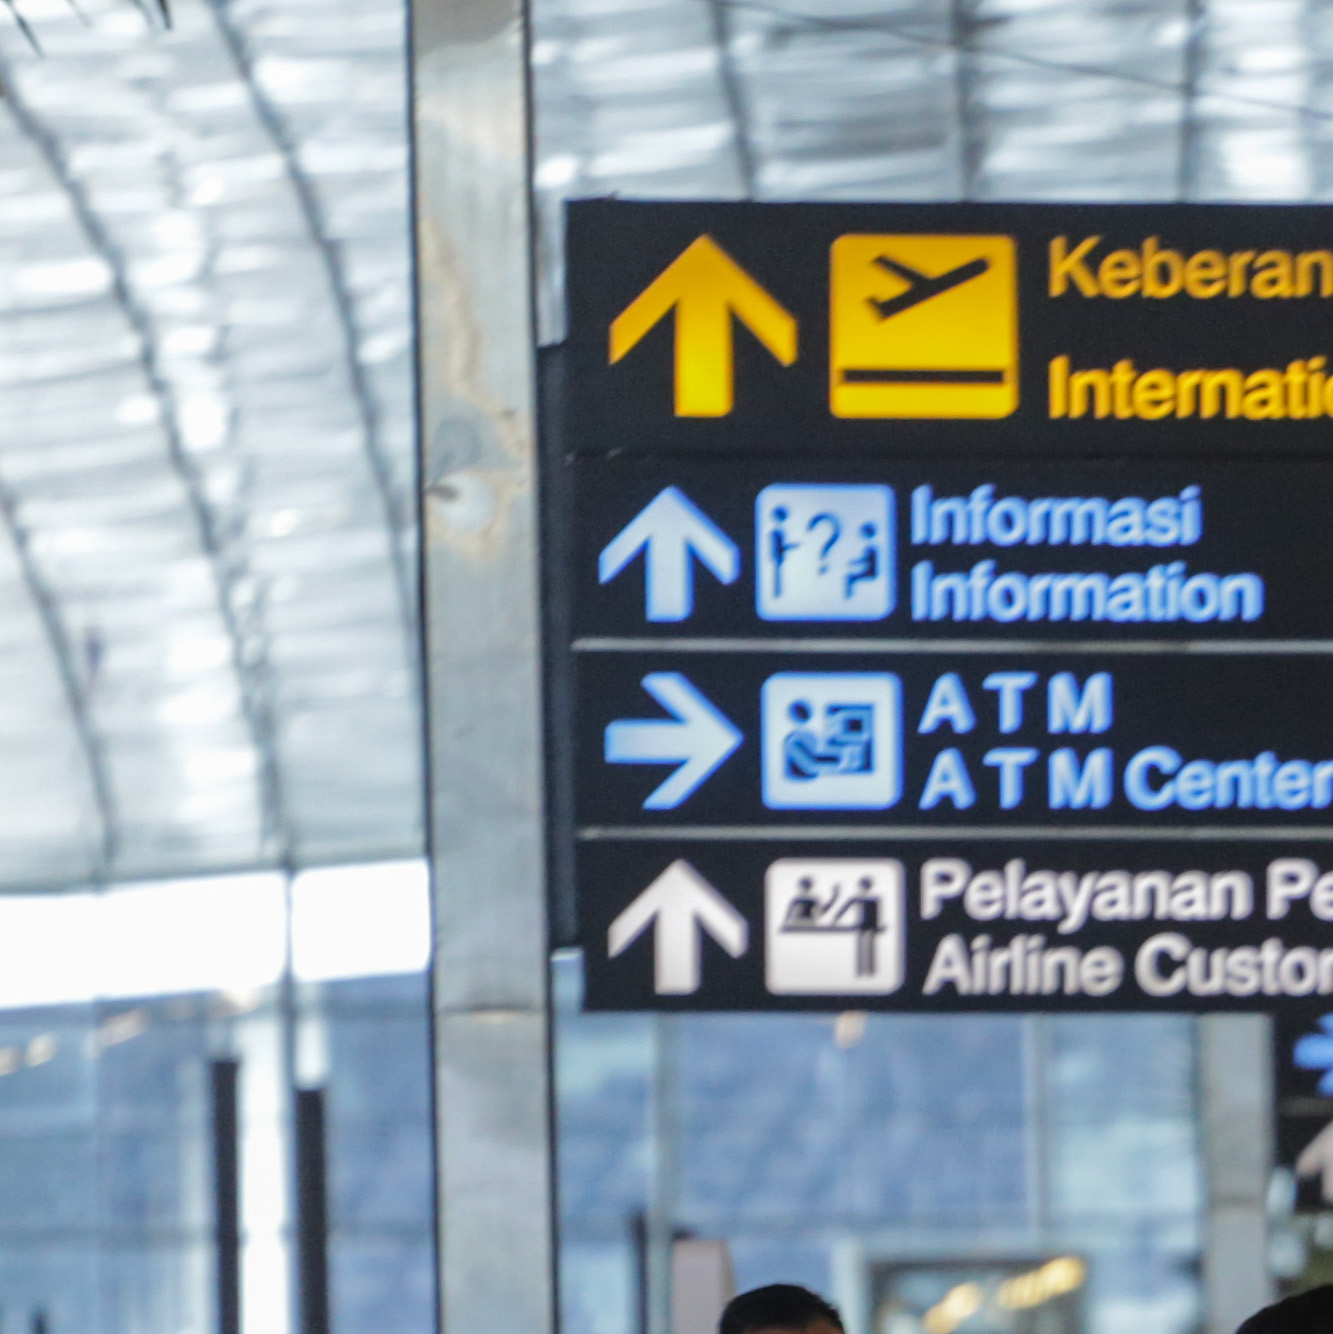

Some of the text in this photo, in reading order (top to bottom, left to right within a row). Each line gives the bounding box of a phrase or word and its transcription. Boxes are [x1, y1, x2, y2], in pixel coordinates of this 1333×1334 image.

[909, 483, 1205, 548] Informasi
[909, 558, 1267, 624] Information
[919, 856, 1254, 934] Pelayanan
[920, 934, 1124, 997] Airline
